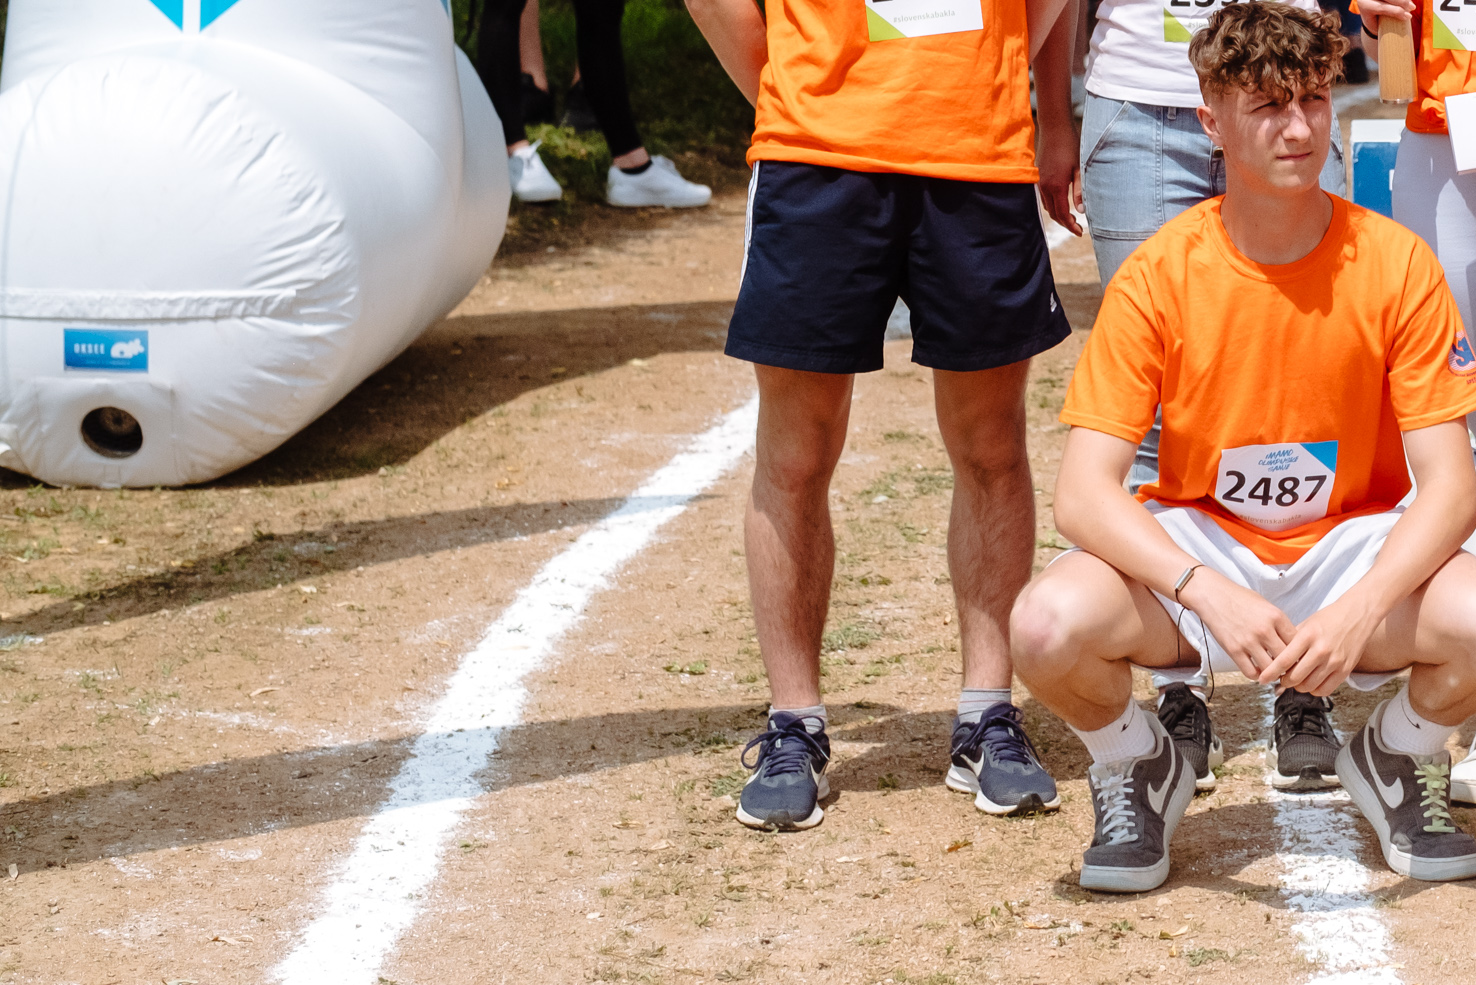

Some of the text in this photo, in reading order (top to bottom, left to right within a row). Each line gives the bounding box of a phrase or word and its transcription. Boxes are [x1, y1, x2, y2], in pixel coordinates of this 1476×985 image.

[893, 10, 956, 24] #slovenskabakla
[1265, 448, 1294, 459] IMAMO
[1221, 470, 1327, 507] 2487
